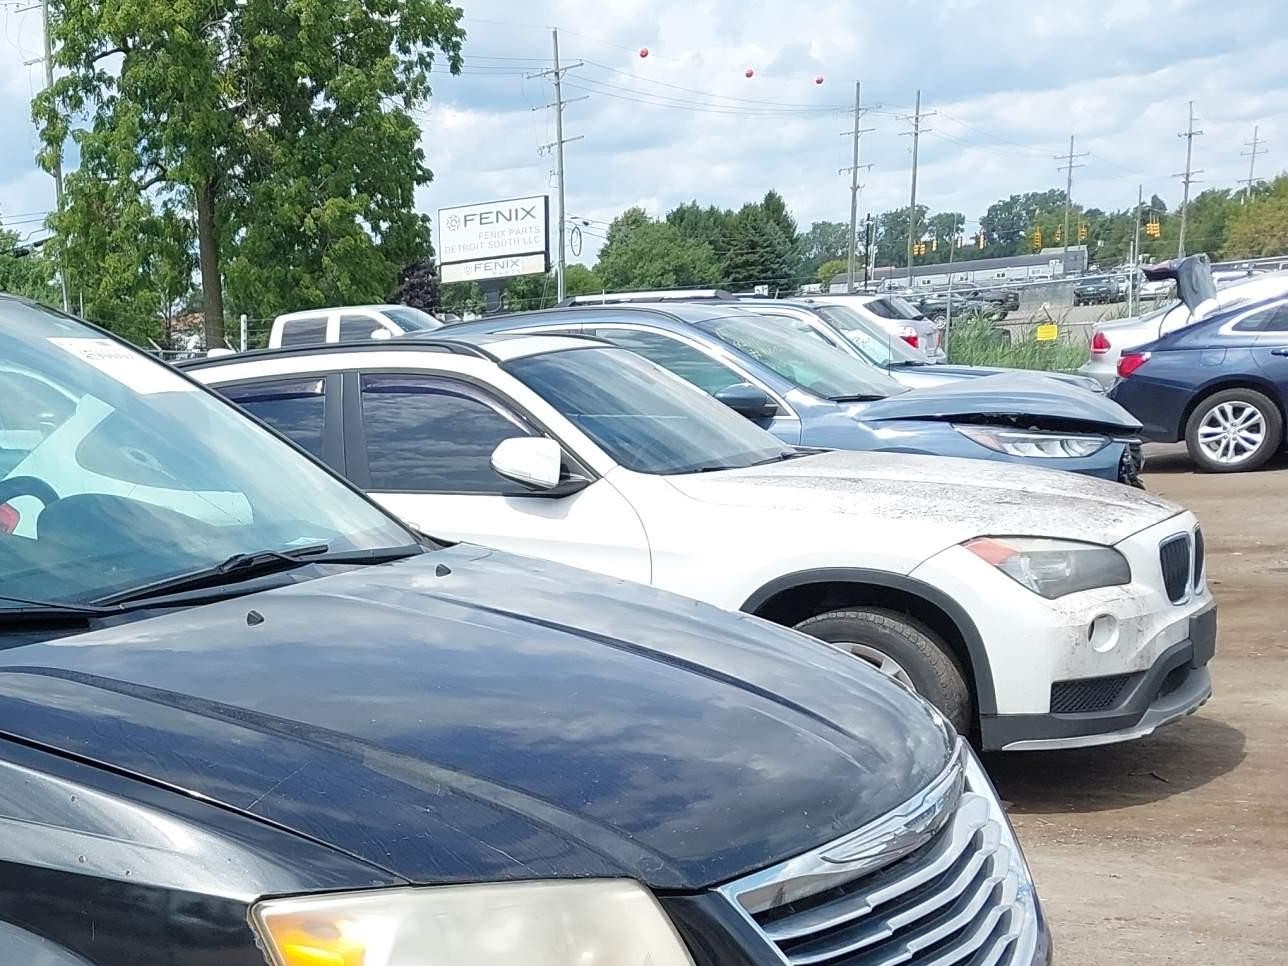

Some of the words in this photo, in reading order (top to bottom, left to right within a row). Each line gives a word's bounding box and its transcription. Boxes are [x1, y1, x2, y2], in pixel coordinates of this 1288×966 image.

[463, 205, 537, 228] FENIX
[478, 230, 506, 241] FENIX
[508, 225, 541, 237] PARTS
[444, 241, 484, 255] DETROIT
[488, 237, 520, 249] SOUTH
[523, 235, 541, 246] LLC
[474, 258, 520, 273] FENIX
